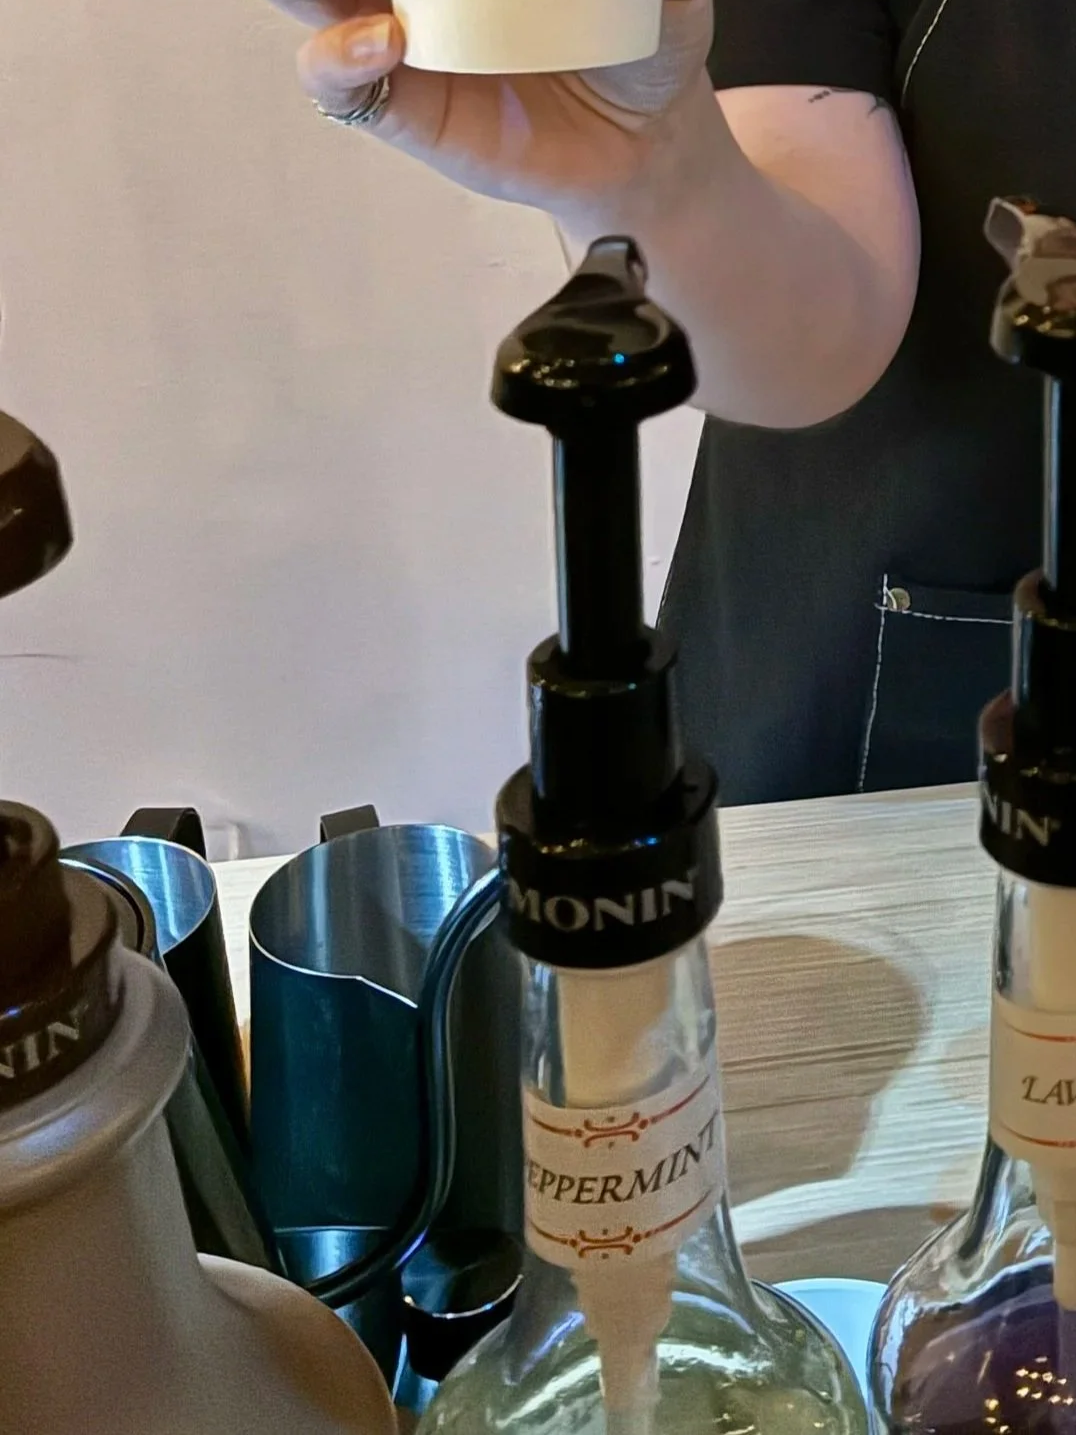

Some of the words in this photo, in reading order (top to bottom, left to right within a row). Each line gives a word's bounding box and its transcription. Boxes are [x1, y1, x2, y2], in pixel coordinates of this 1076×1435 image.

[981, 788, 1053, 847] NIN
[0, 1004, 87, 1079] NIN
[526, 1109, 720, 1205] EPPERMINT
